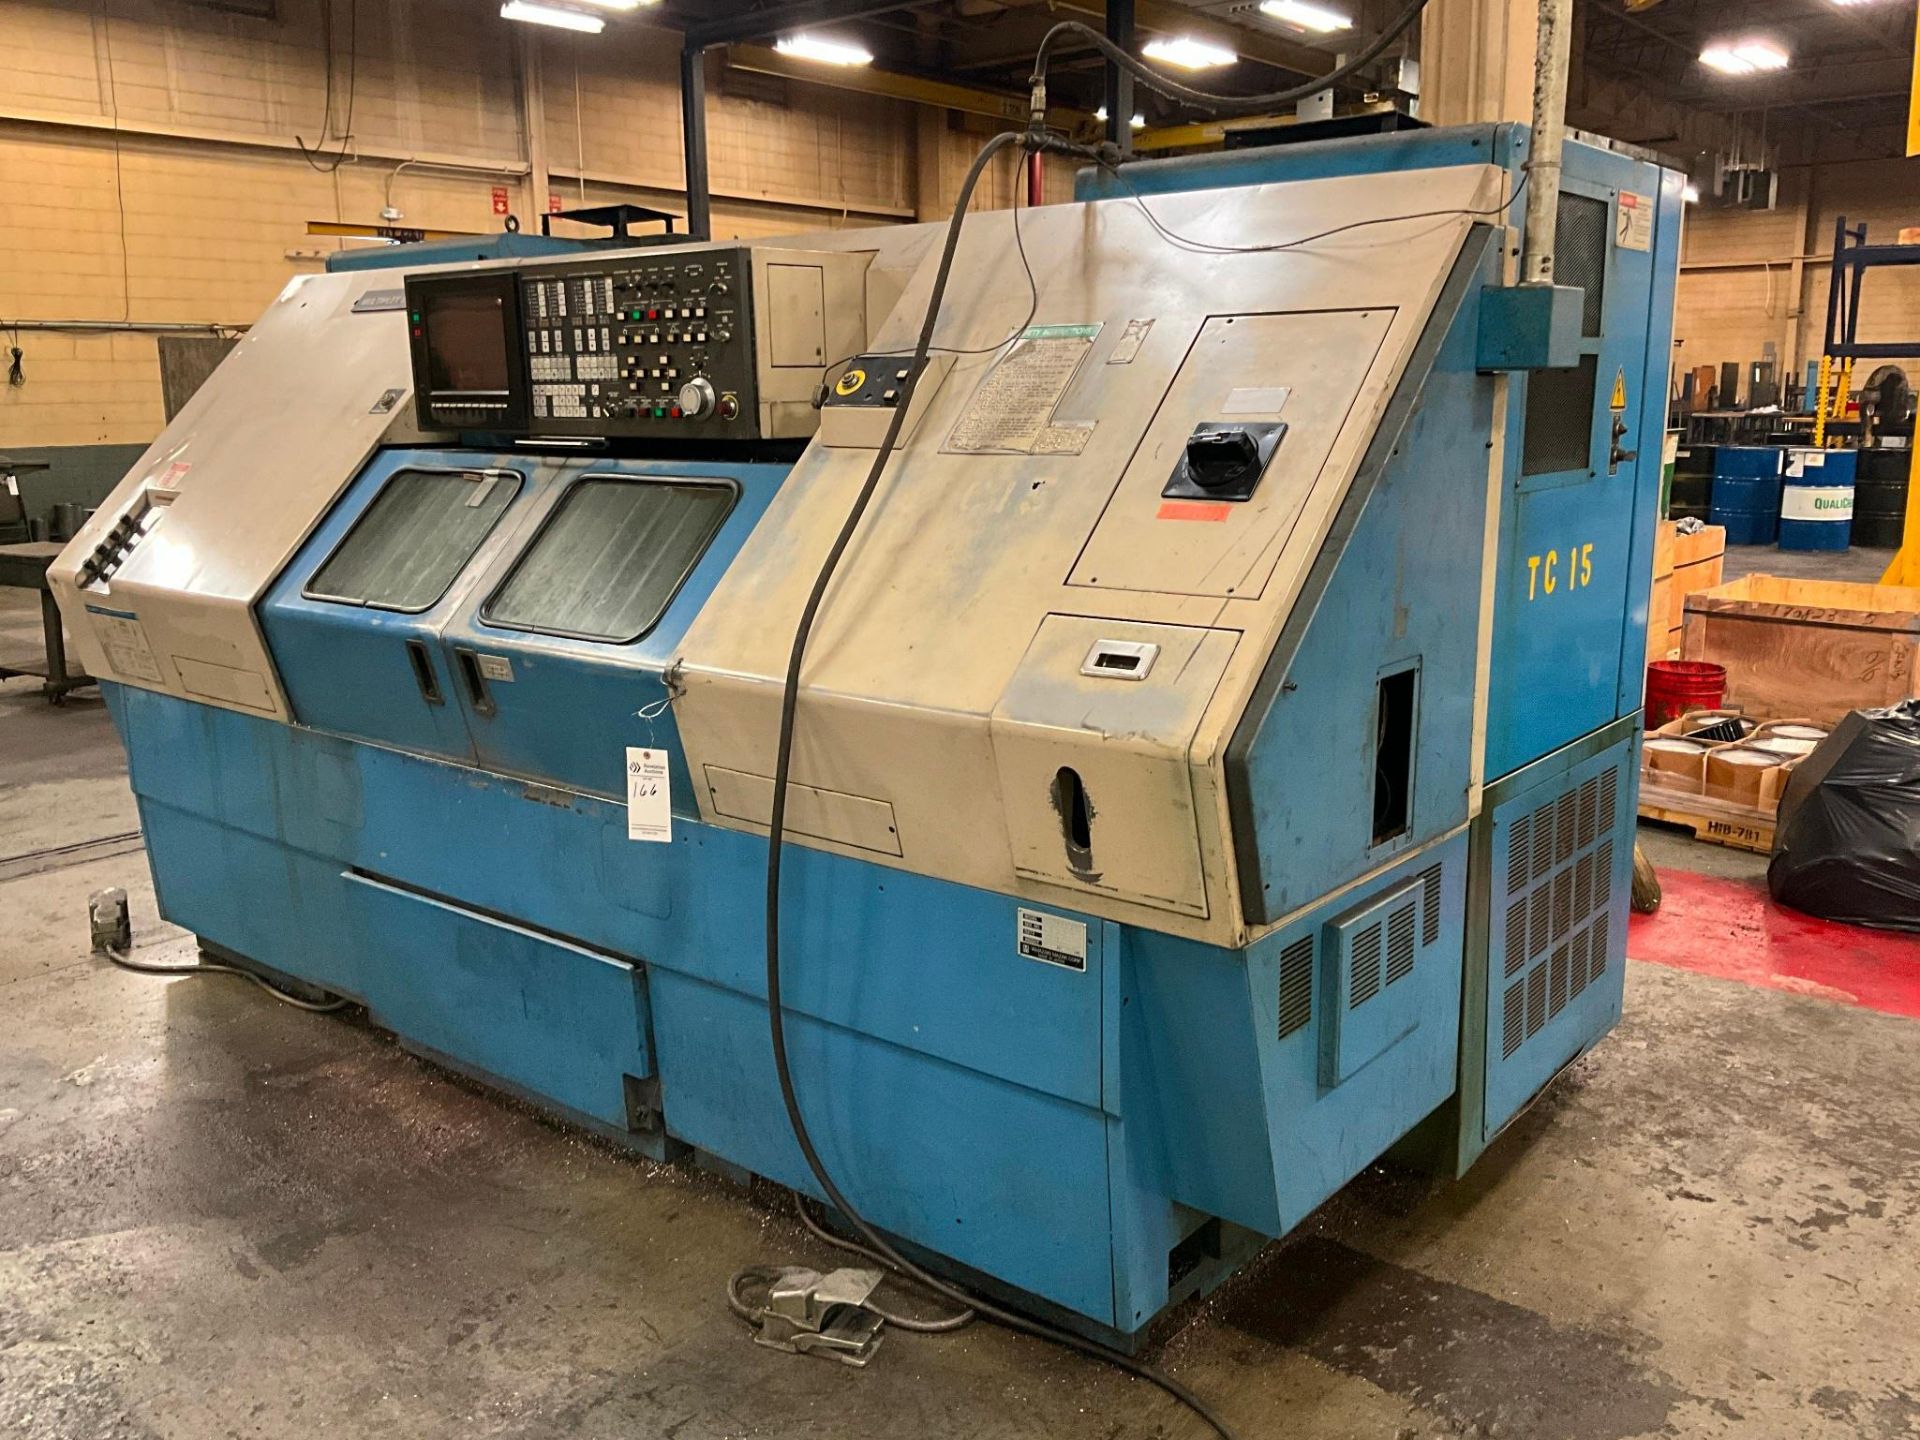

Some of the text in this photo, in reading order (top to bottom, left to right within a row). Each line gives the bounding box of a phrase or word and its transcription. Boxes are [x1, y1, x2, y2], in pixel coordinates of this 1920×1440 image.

[1527, 543, 1594, 601] TC 15
[633, 781, 658, 798] 166
